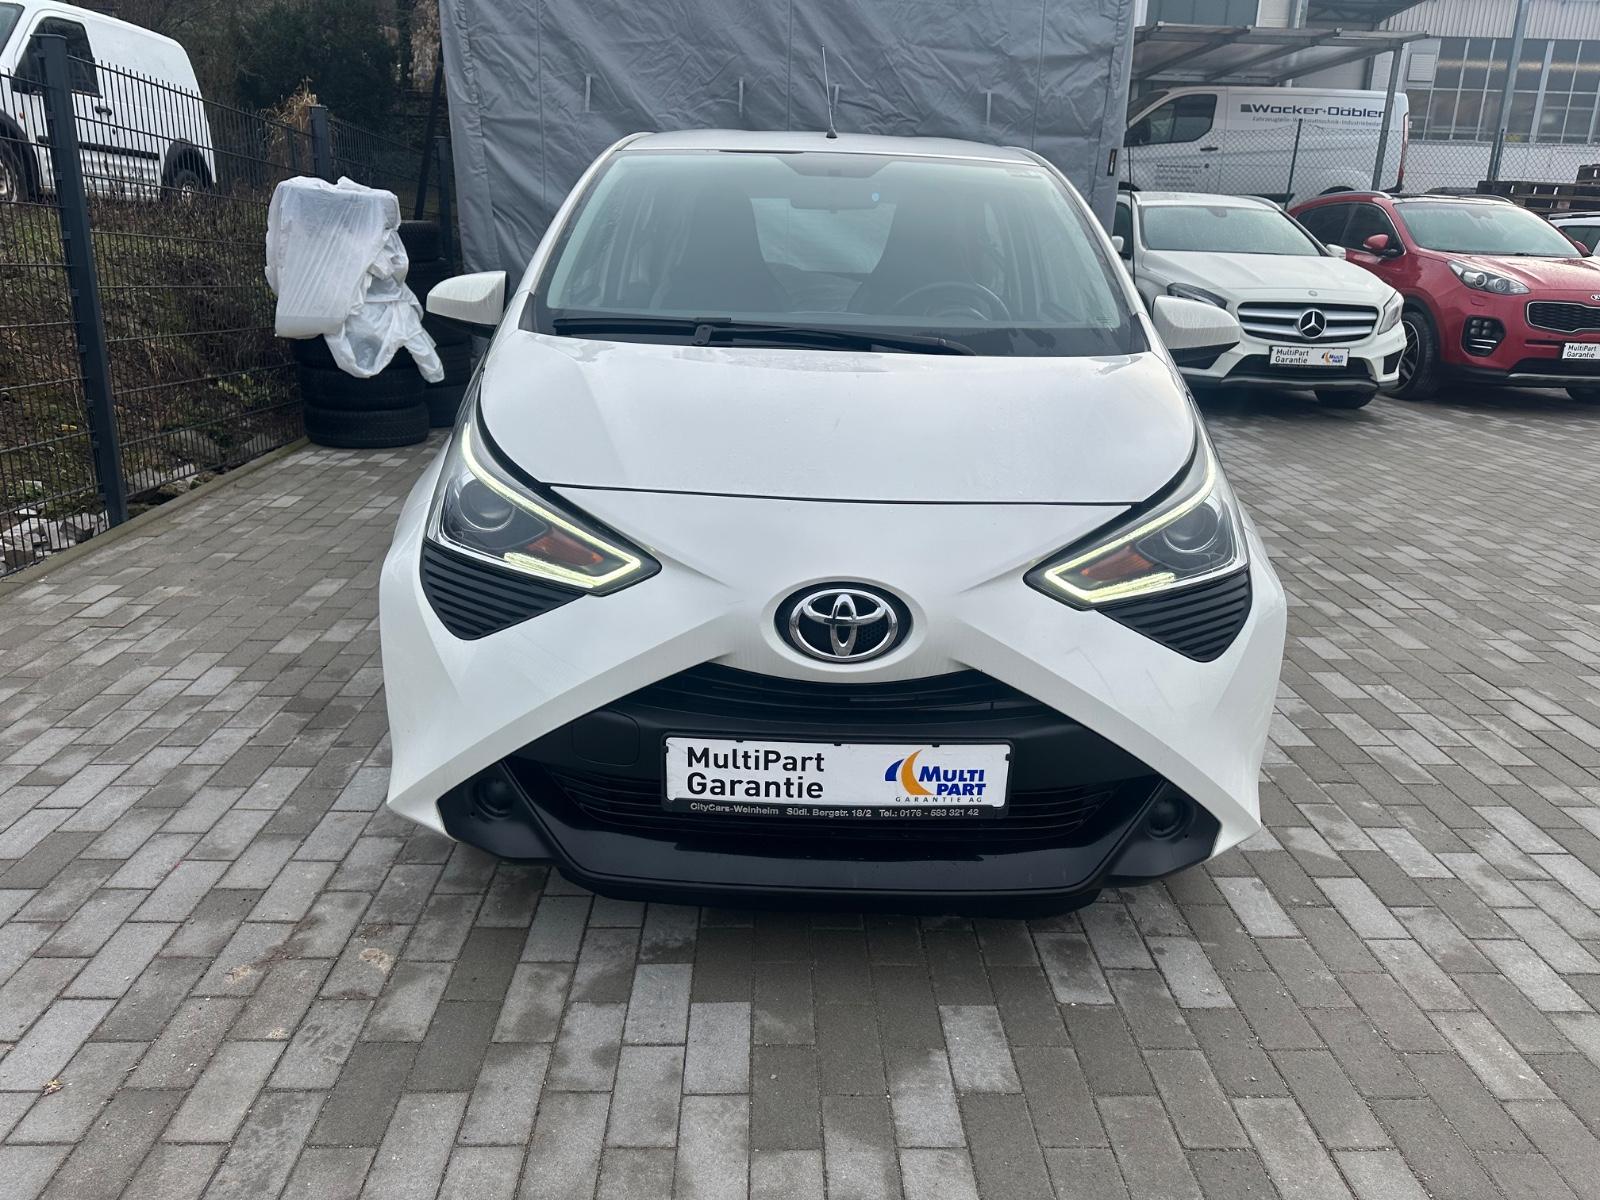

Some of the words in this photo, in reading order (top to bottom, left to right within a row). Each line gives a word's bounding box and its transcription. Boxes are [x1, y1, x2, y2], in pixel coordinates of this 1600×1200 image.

[687, 746, 825, 772] MultiPart
[918, 766, 985, 782] MULTI
[687, 772, 824, 799] Garantie
[936, 783, 987, 796] PART
[690, 802, 779, 815] CityCars-Weinheim
[786, 807, 810, 816] Südl.
[812, 808, 849, 818] Bergstr.
[851, 809, 872, 817] 18/2
[879, 809, 898, 817] Tel.:
[900, 809, 922, 817] 0176
[967, 808, 979, 816] 42
